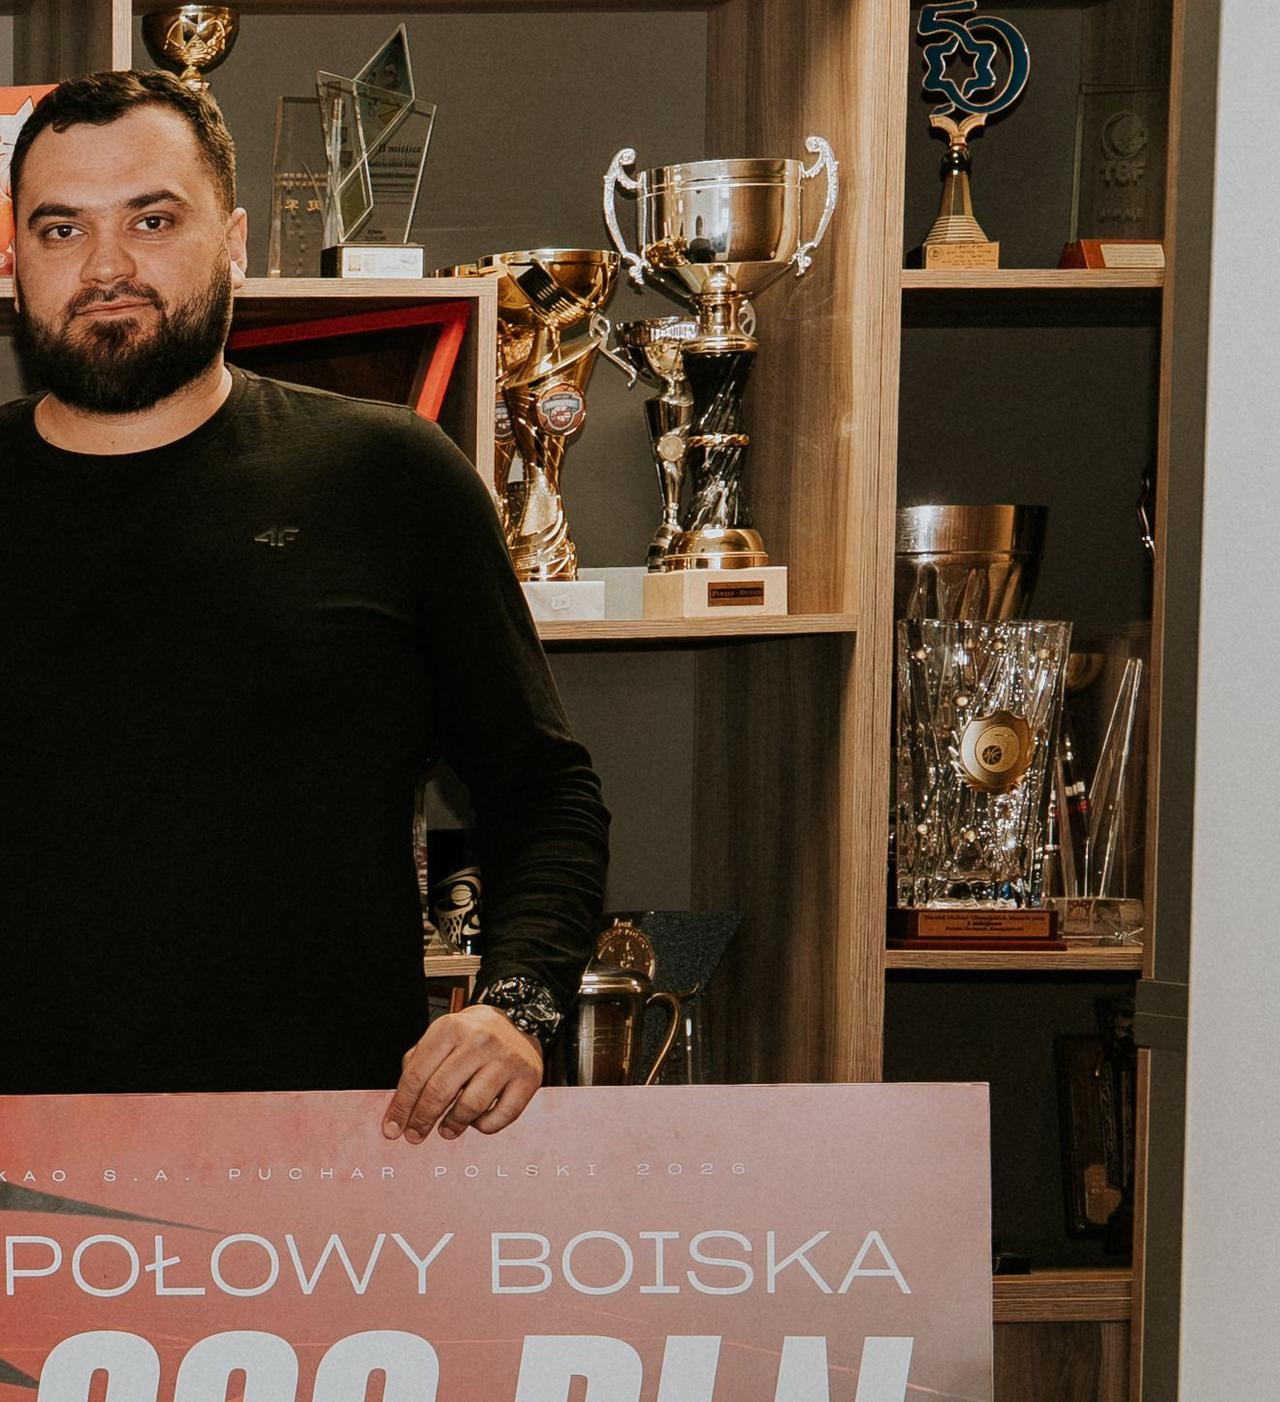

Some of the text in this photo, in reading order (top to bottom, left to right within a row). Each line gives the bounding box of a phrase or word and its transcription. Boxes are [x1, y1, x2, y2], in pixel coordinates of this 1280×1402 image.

[254, 527, 300, 547] 4F
[103, 1167, 192, 1182] S.A.
[229, 1166, 397, 1180] PUCHAR
[435, 1163, 600, 1178] POLSKI
[637, 1161, 748, 1176] 2026
[5, 1232, 455, 1298] POŁOWY
[491, 1230, 913, 1296] BOISKA
